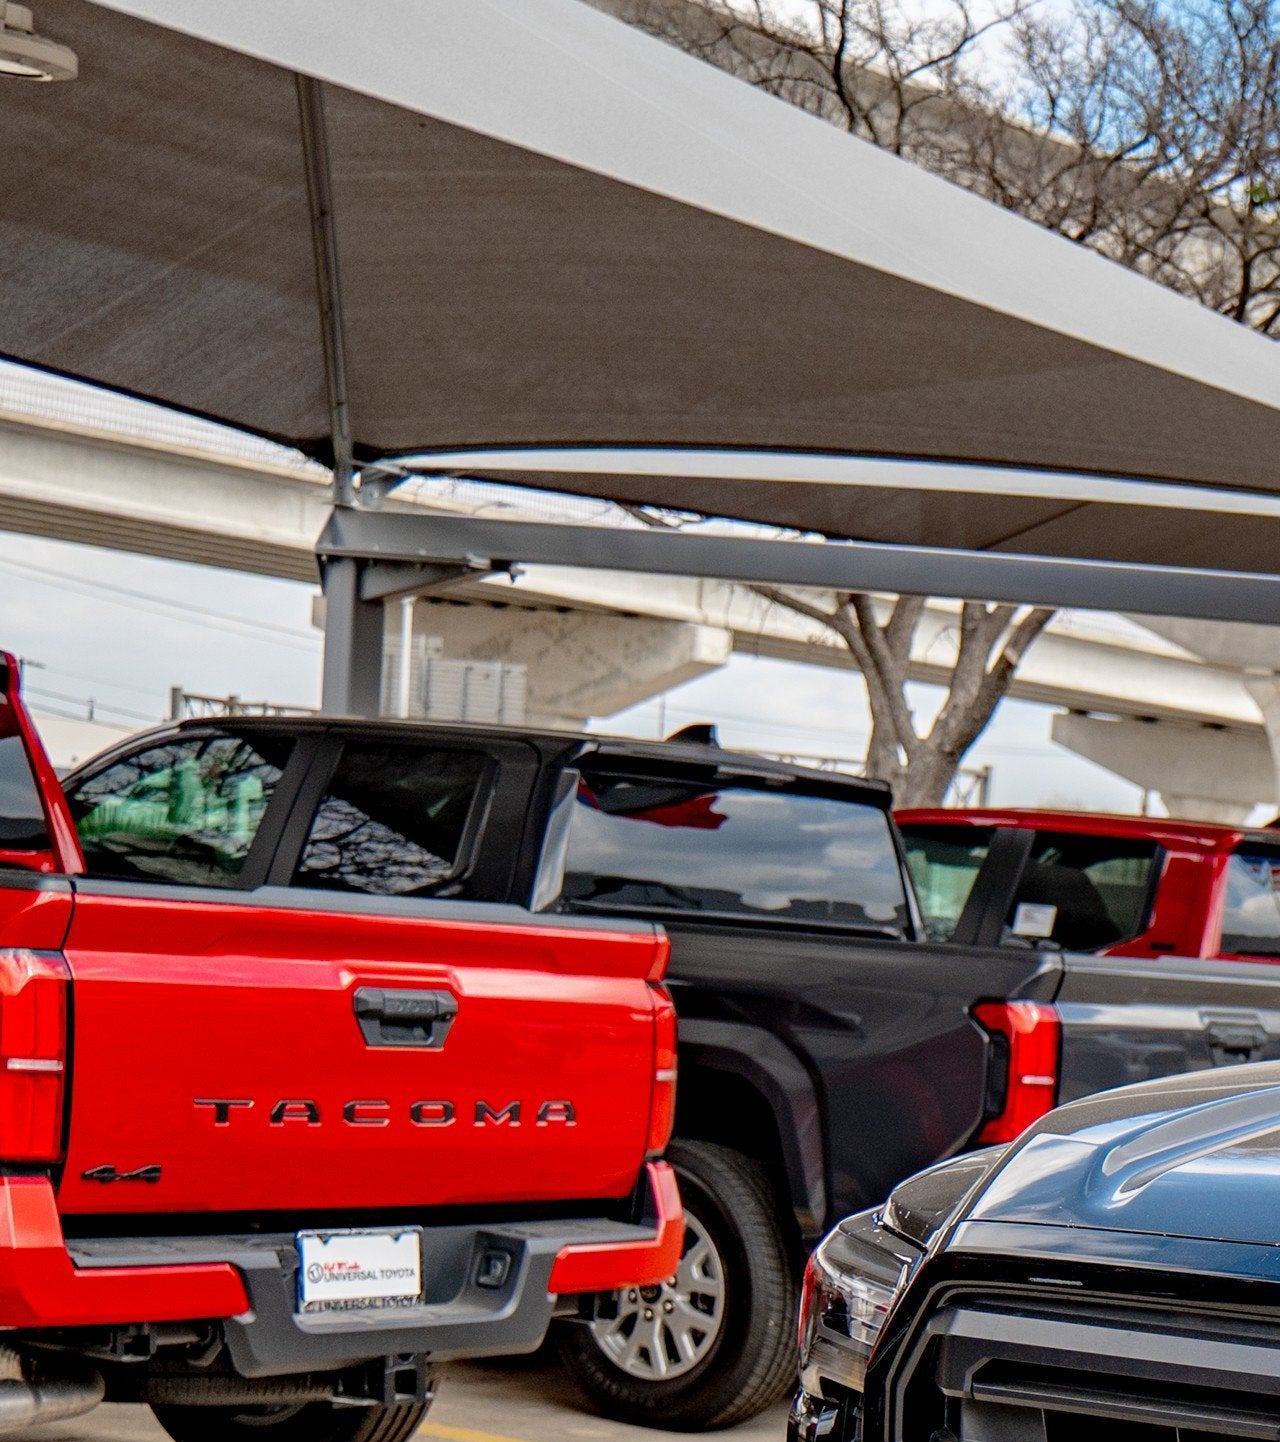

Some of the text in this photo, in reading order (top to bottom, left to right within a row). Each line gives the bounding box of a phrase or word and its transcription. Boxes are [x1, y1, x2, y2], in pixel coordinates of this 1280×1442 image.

[193, 1098, 578, 1128] TACOMA
[324, 1268, 416, 1282] UNIVERSAL TOYOTA
